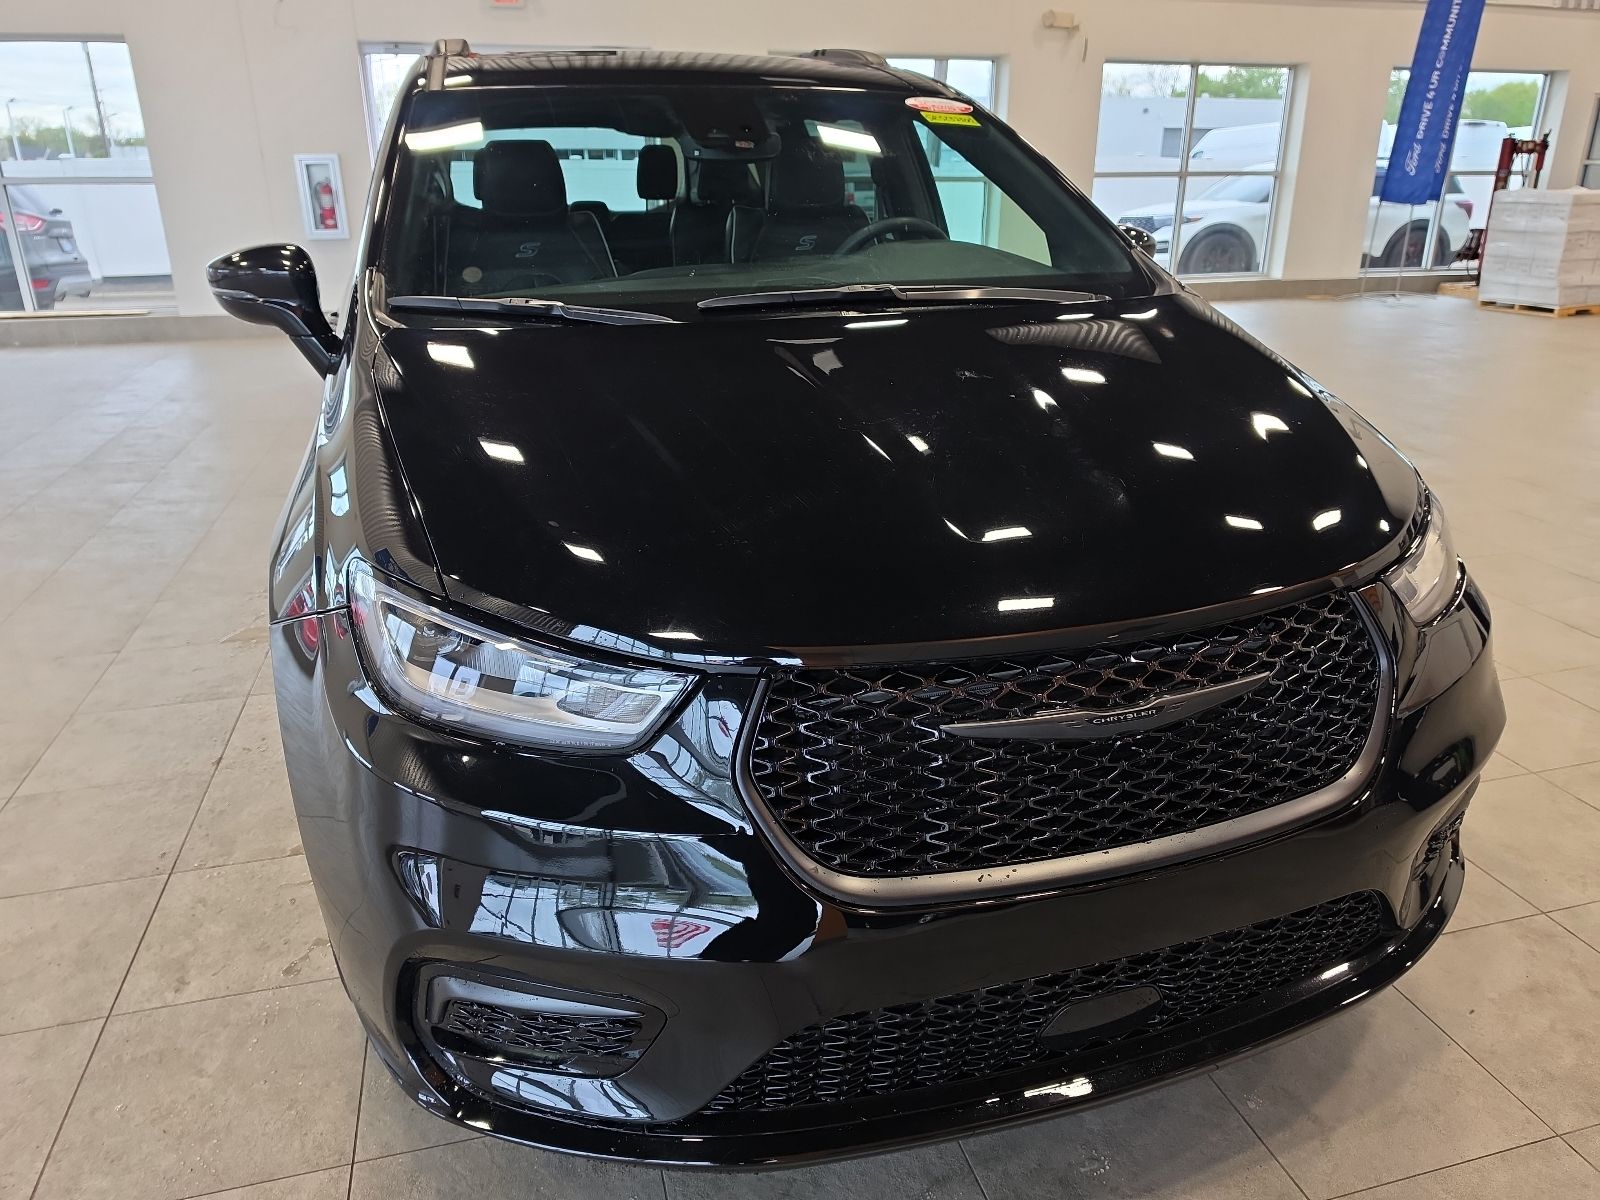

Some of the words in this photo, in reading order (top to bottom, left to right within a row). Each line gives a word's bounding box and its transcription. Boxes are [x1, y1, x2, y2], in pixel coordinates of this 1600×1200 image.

[1429, 70, 1441, 89] UR
[1426, 90, 1436, 99] 4
[1416, 101, 1433, 139] DRIVE
[1405, 142, 1422, 176] Ford
[1092, 709, 1157, 724] CHRYSLER
